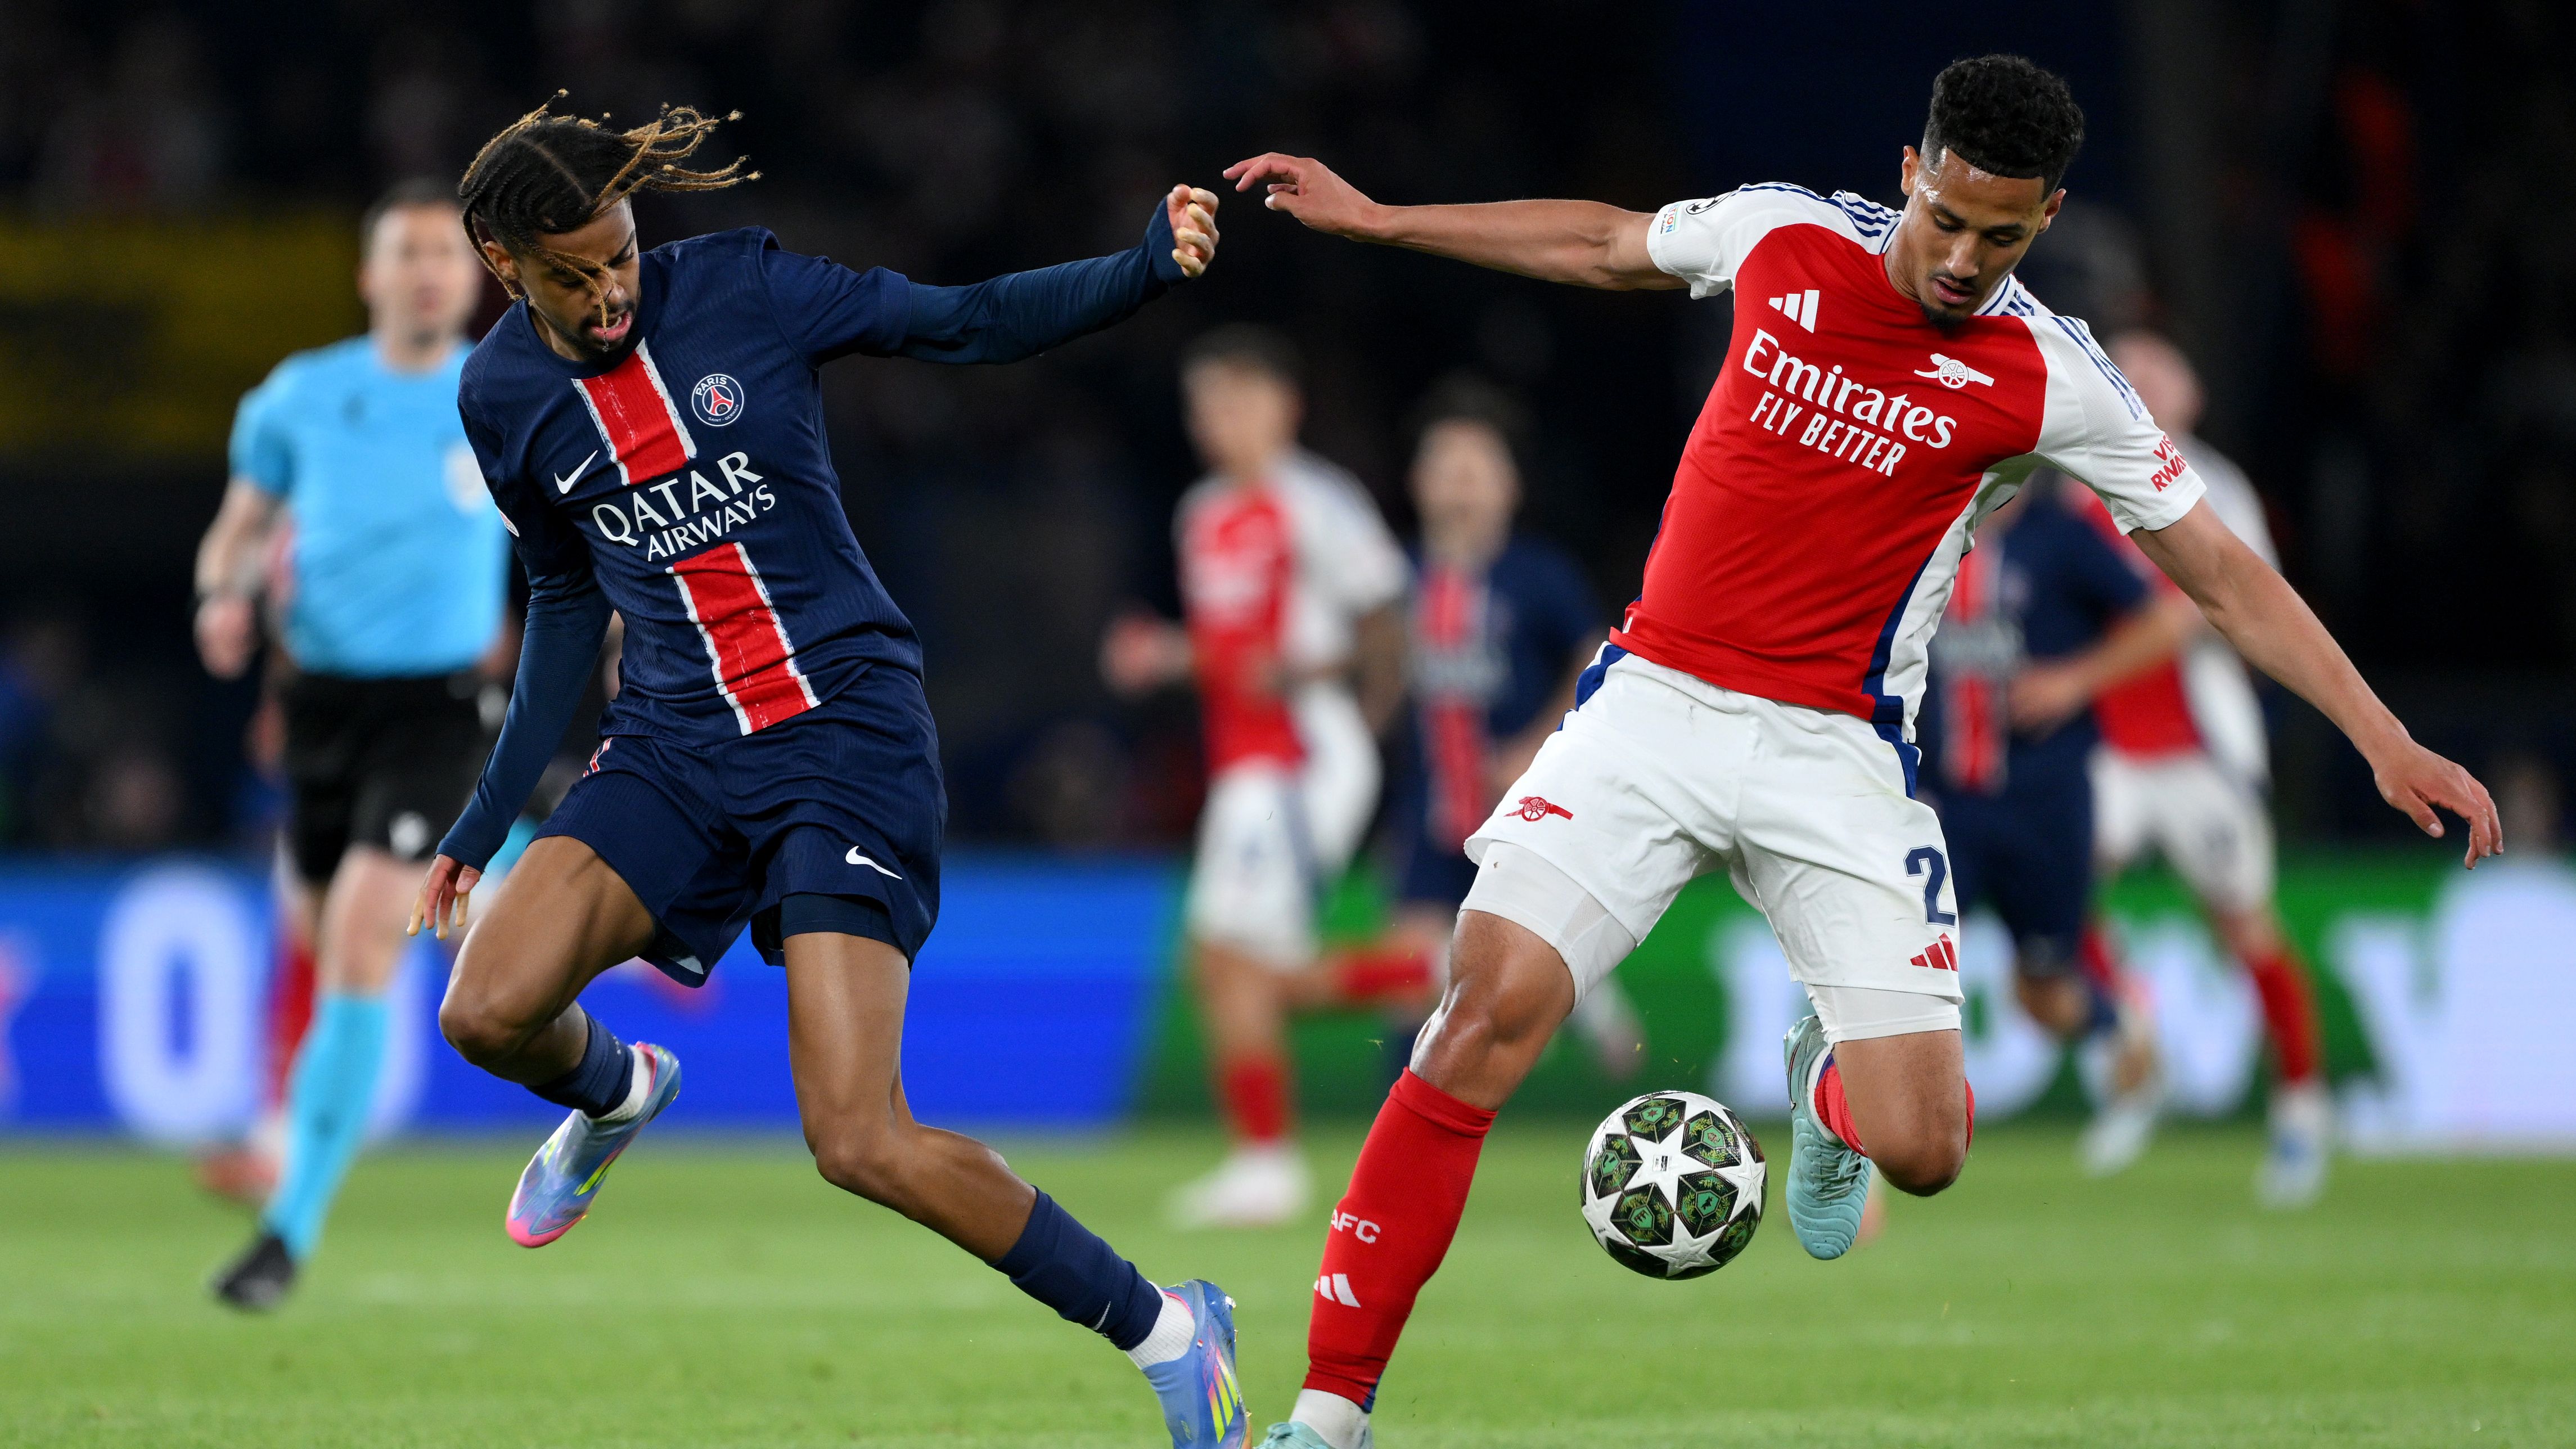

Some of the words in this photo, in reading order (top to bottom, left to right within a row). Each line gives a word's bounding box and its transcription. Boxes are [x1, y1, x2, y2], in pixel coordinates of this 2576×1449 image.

[695, 376, 727, 396] PARIS
[1744, 328, 1957, 448] Emirates
[1750, 391, 1803, 436] FLY
[1799, 413, 1906, 477] BETTER
[2152, 434, 2175, 461] VIS
[592, 451, 764, 547] QATAR
[647, 484, 776, 562] AIRWAYS
[1903, 845, 1957, 928] 2
[1331, 1208, 1381, 1244] AFC
